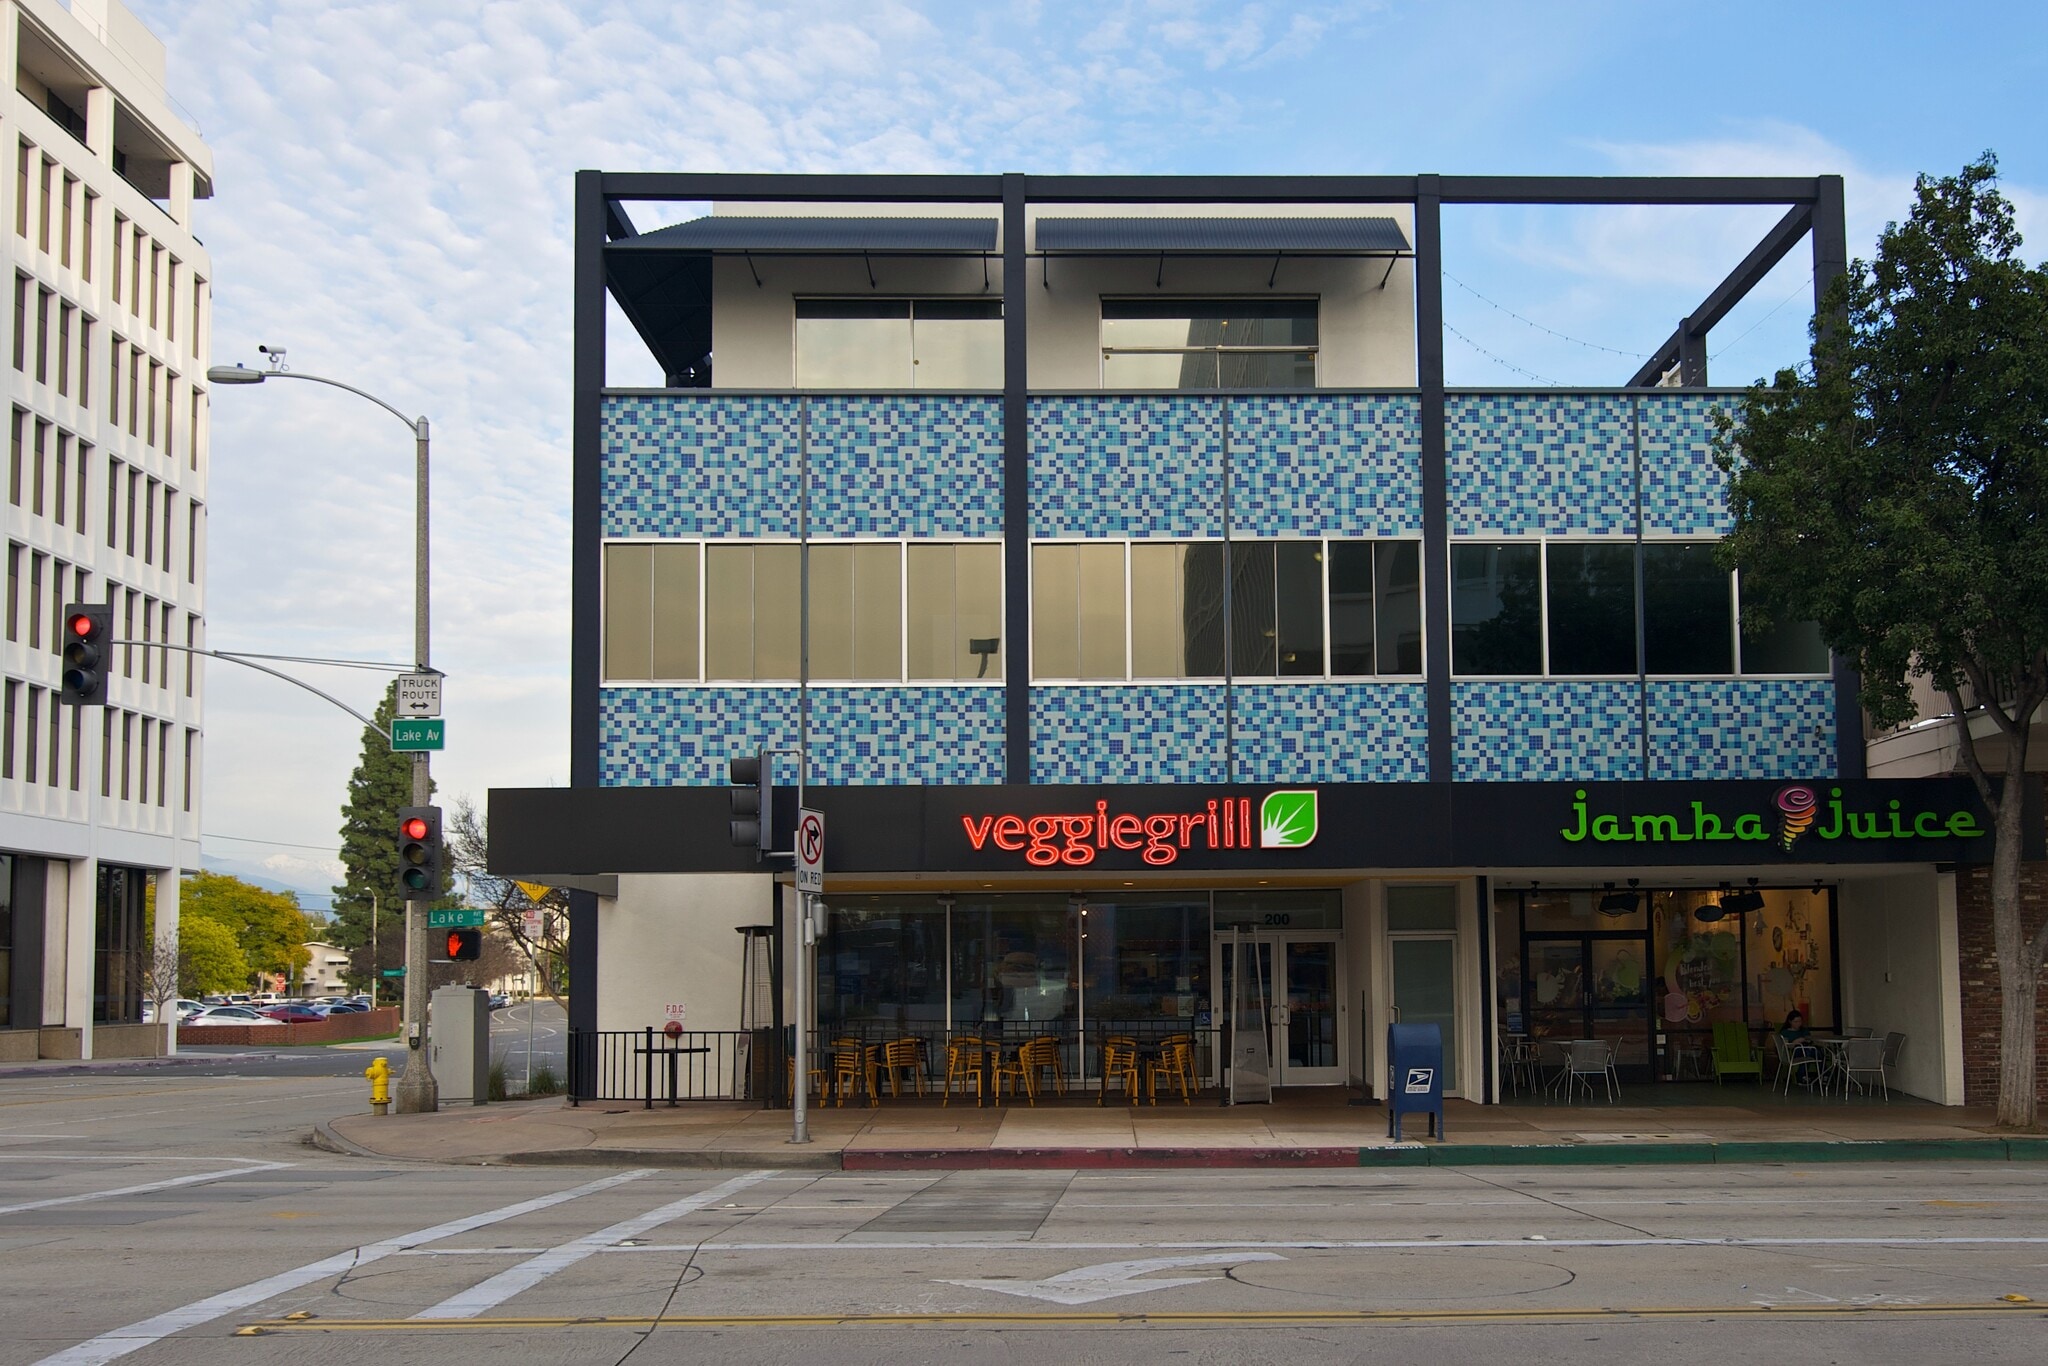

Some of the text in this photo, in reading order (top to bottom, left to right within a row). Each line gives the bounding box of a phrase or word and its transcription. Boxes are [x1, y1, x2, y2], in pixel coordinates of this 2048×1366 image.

[402, 679, 438, 688] TRUCK
[402, 691, 438, 699] ROUTE
[396, 729, 440, 741] Lake Av
[1560, 787, 1986, 842] jamba juice
[961, 797, 1251, 867] veggiegrill
[800, 870, 821, 885] ON RED
[430, 912, 464, 924] Lake
[1265, 913, 1290, 926] 200
